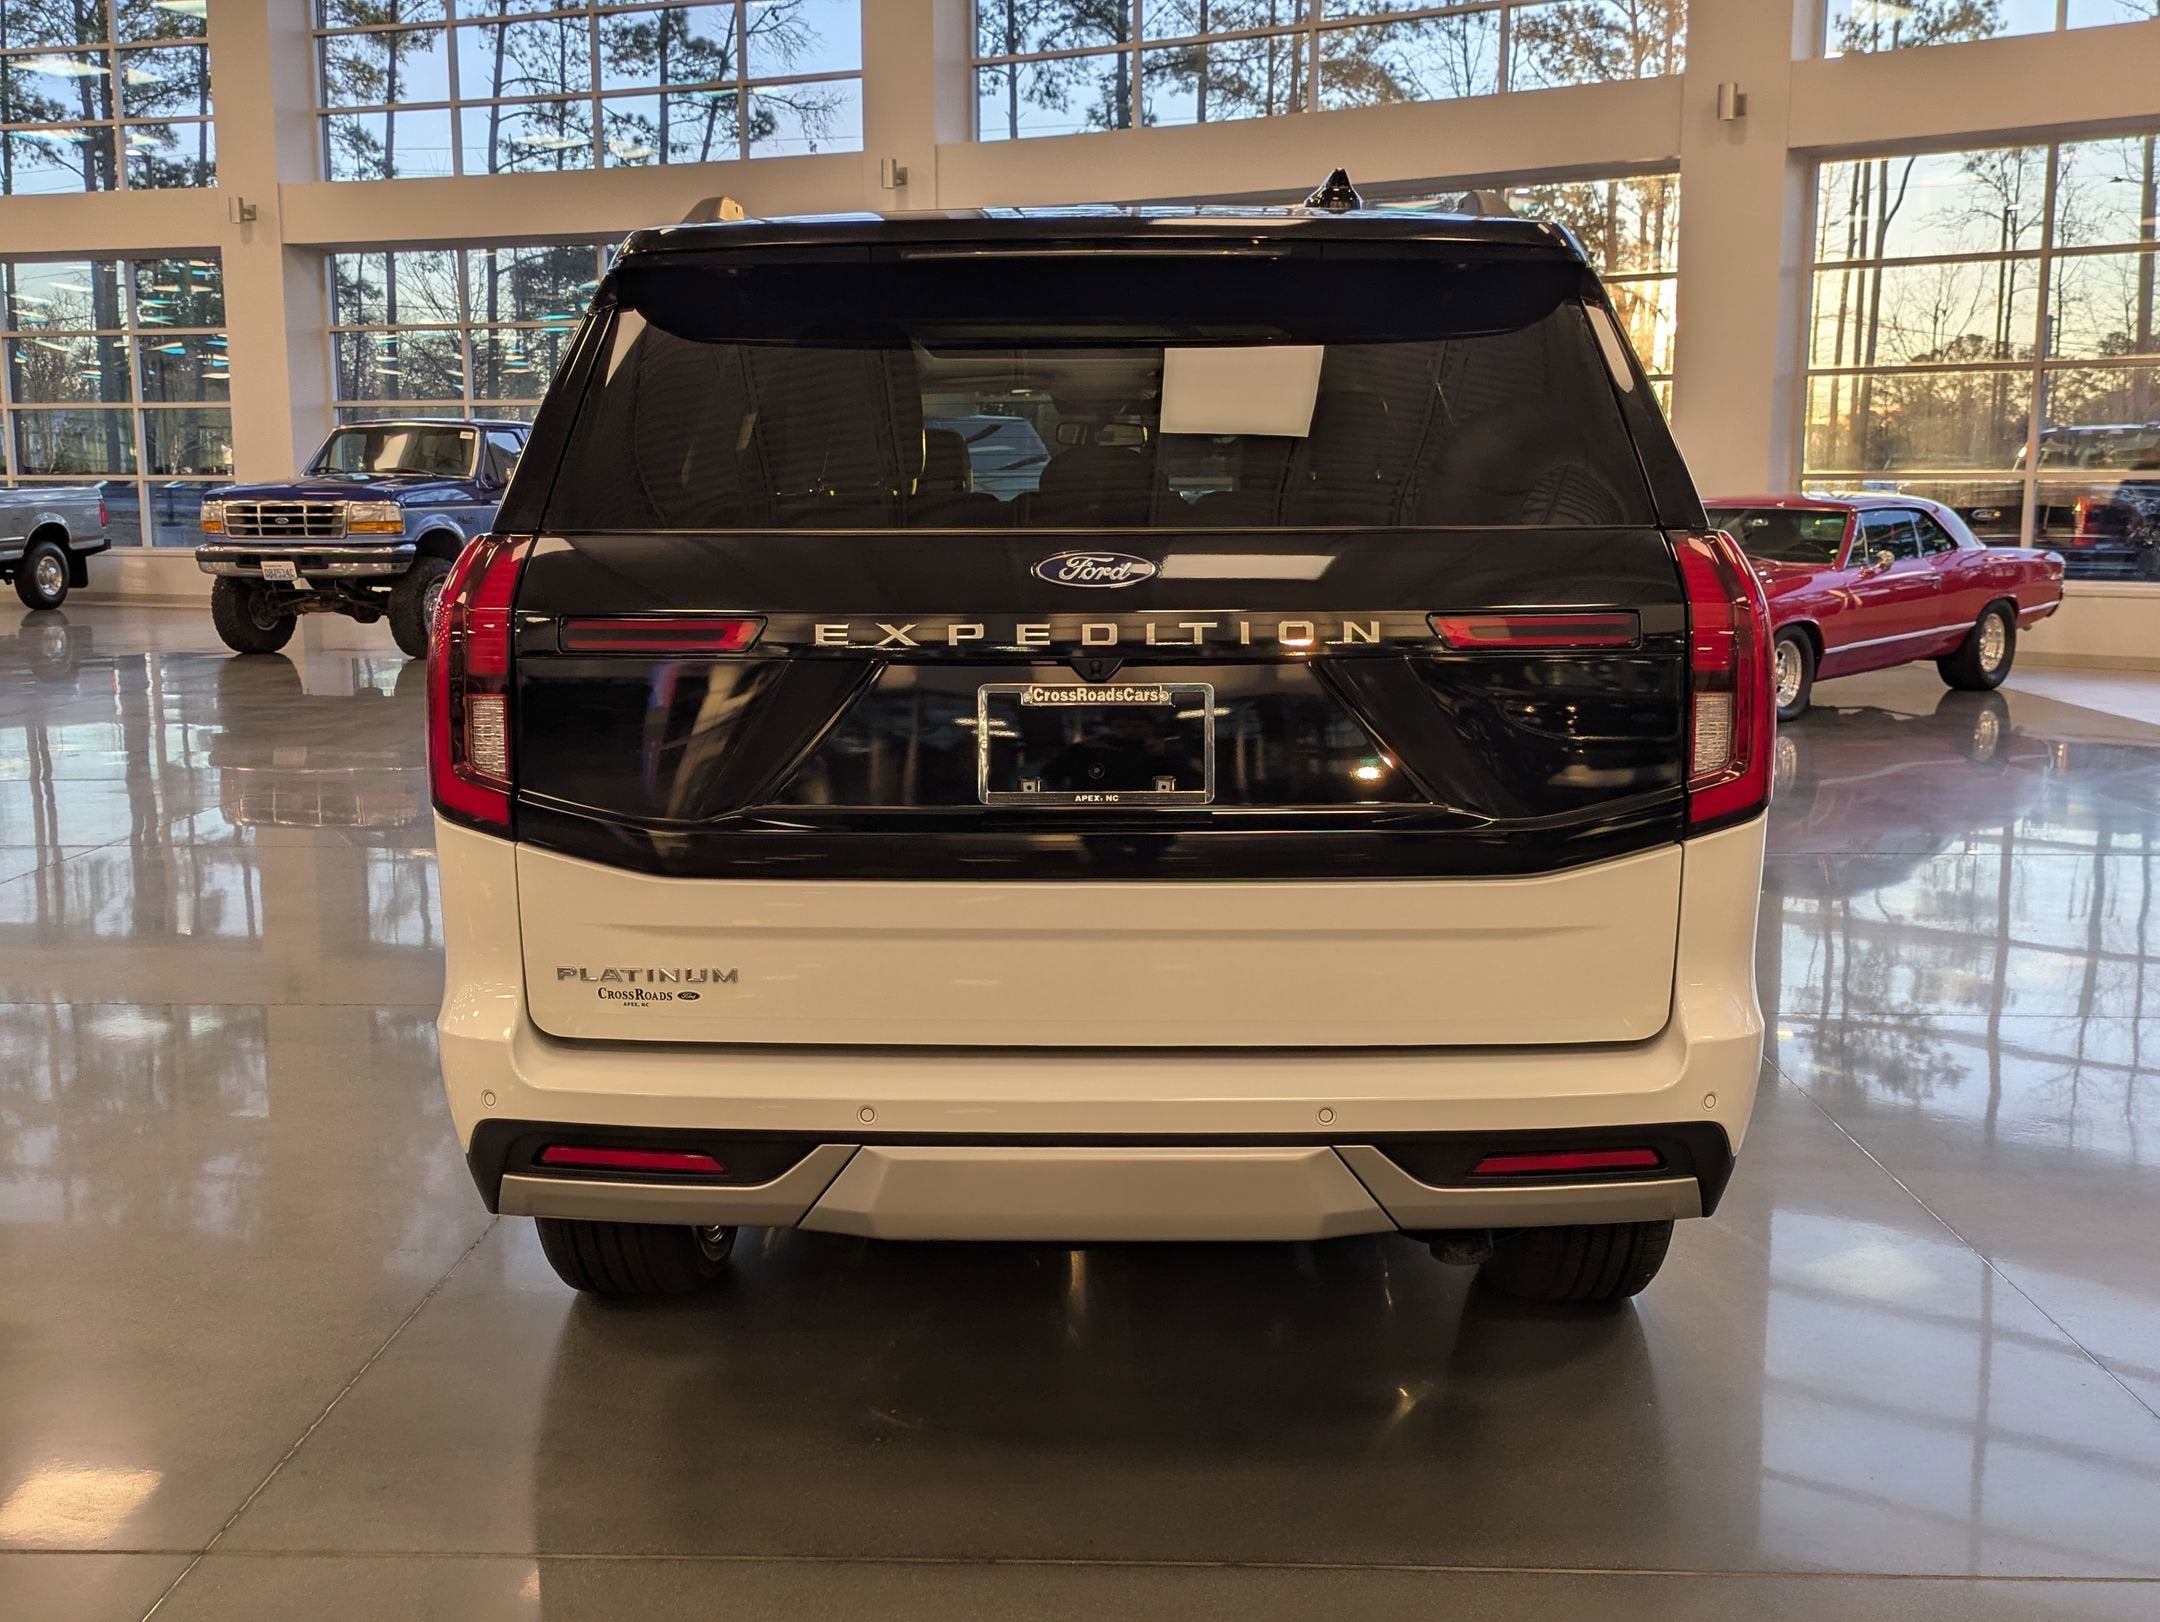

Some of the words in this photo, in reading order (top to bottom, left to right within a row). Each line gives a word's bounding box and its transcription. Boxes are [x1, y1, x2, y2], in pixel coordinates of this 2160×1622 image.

[1059, 556, 1131, 580] Ford
[815, 621, 1380, 646] EXPEDITION
[1033, 687, 1159, 702] CrossRoadsCars
[1074, 794, 1103, 802] APEX,
[1105, 794, 1119, 802] NC
[556, 967, 739, 984] PLATINUM
